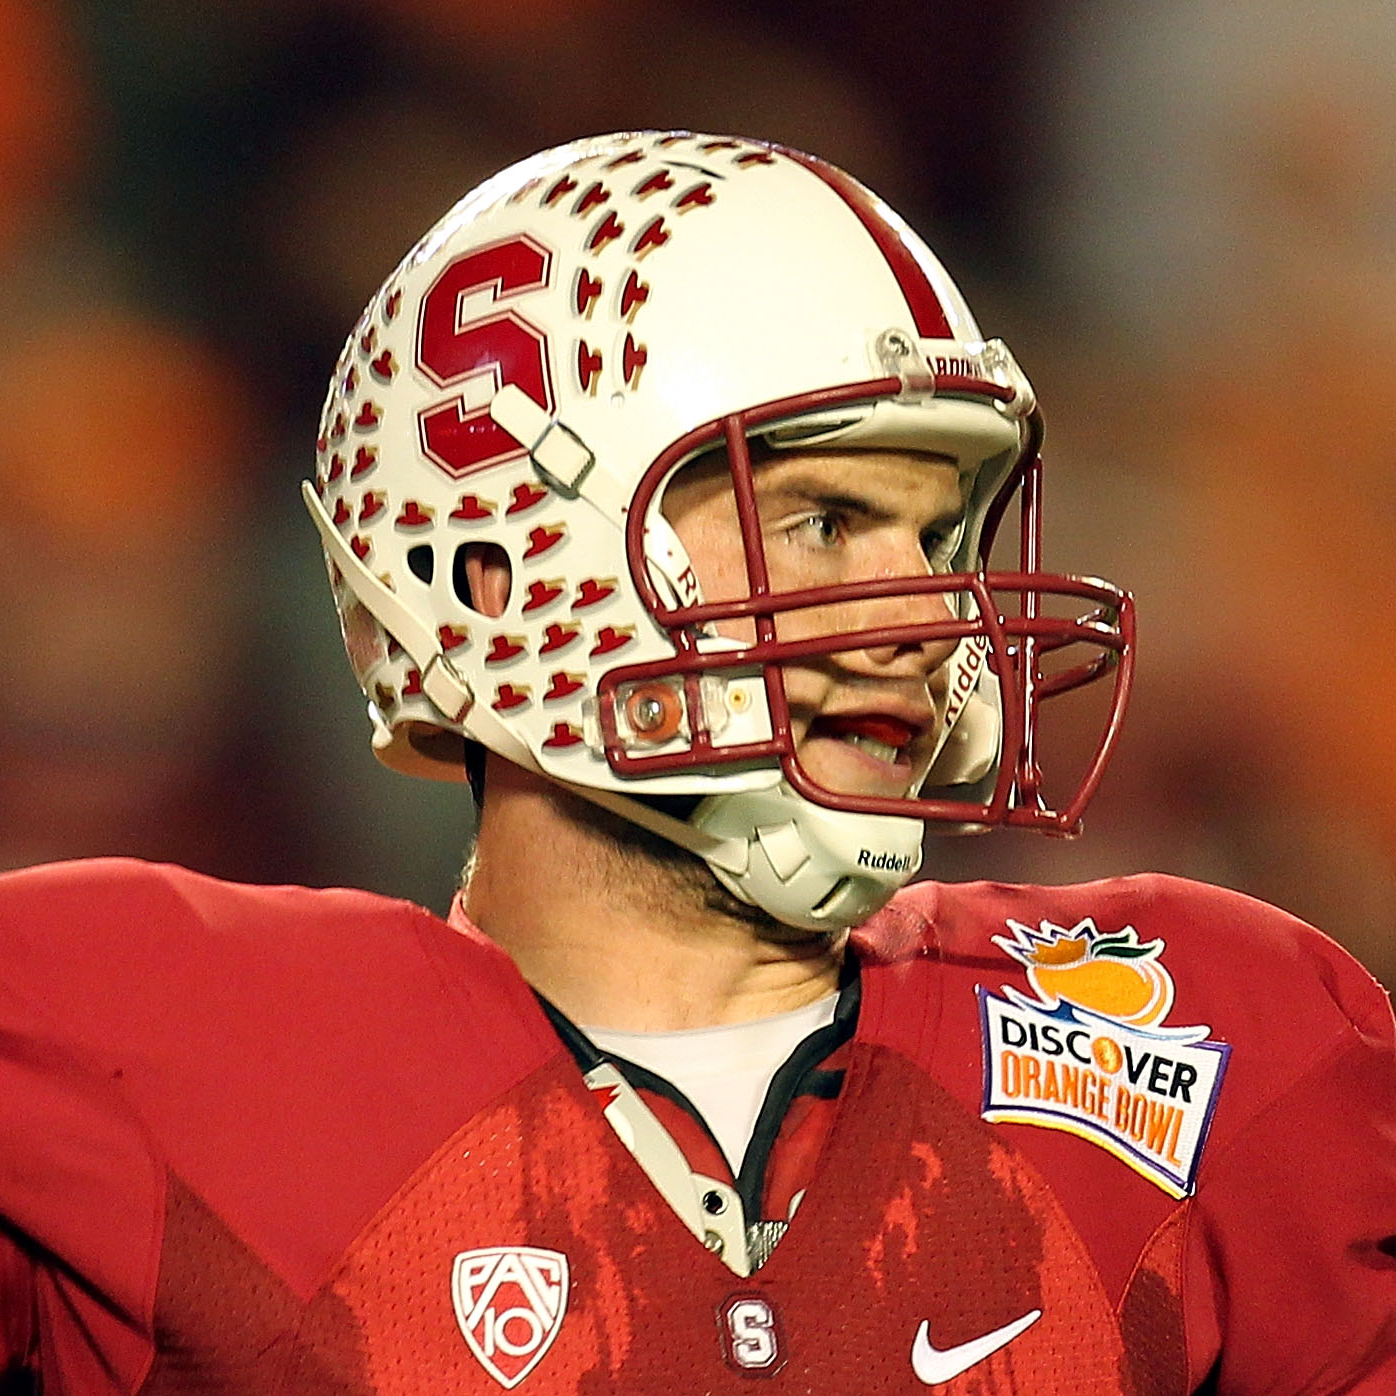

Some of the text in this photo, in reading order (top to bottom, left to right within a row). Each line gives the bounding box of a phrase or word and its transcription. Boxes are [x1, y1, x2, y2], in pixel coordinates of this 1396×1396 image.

[415, 232, 556, 480] S
[857, 848, 911, 872] Riddell
[1000, 1015, 1198, 1103] DISCOVER
[1000, 1050, 1185, 1168] ORANGE BOWL
[459, 1253, 562, 1333] PAC
[483, 1306, 544, 1358] 10
[727, 1299, 777, 1369] S
